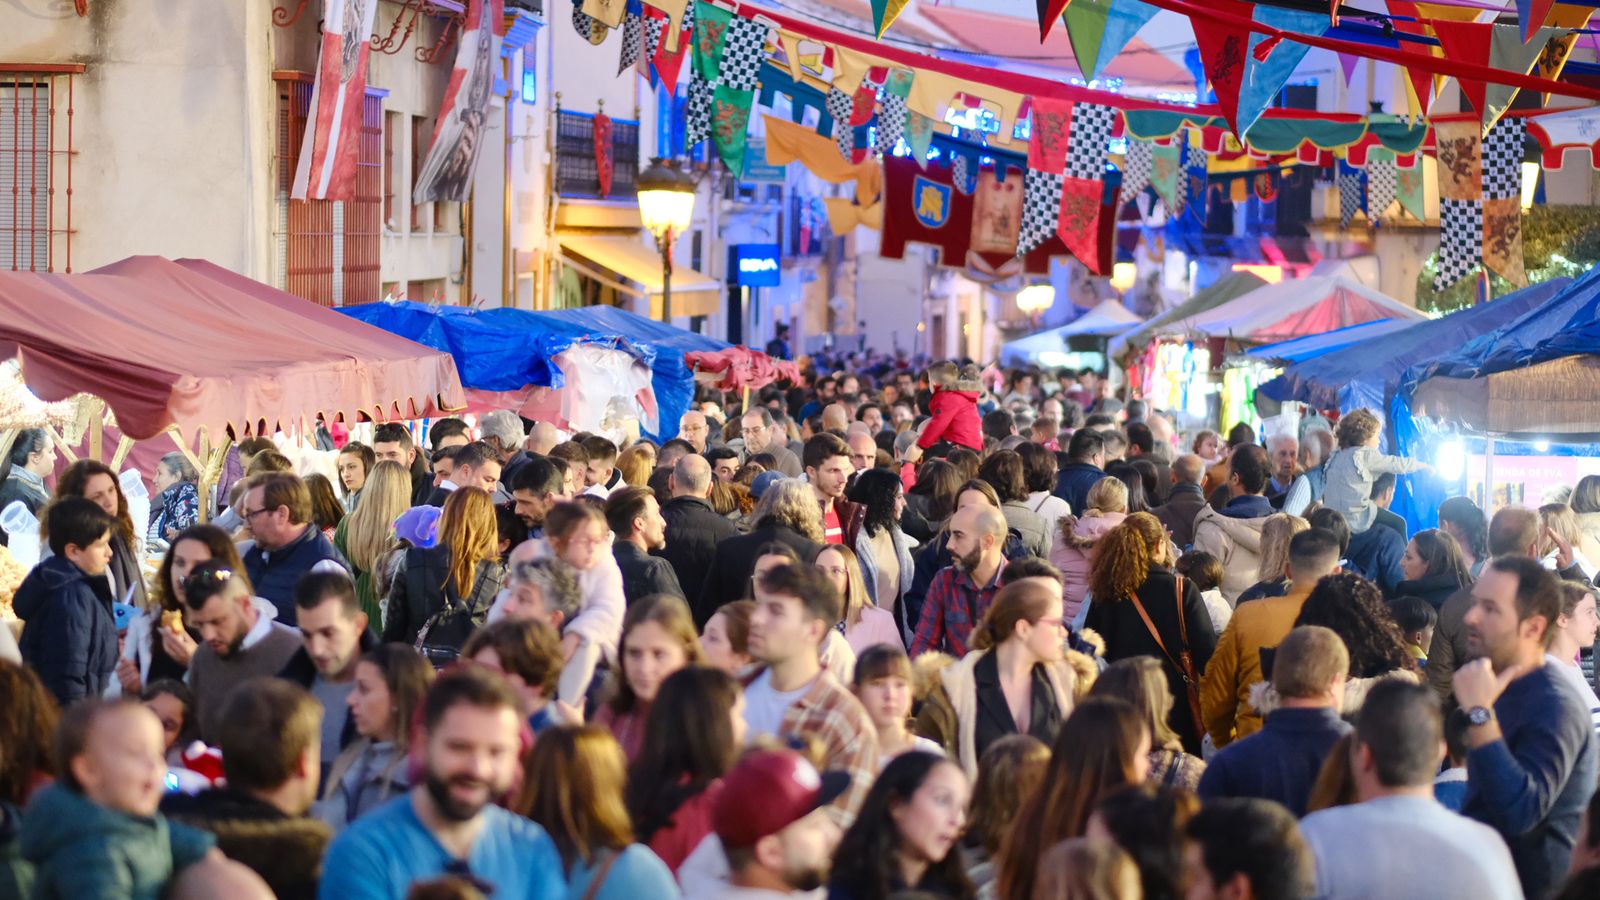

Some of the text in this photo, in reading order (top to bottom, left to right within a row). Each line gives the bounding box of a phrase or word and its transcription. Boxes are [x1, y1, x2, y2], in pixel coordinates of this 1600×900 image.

[740, 258, 778, 272] BBVA
[1528, 468, 1541, 478] DE
[1544, 468, 1563, 479] EVA
